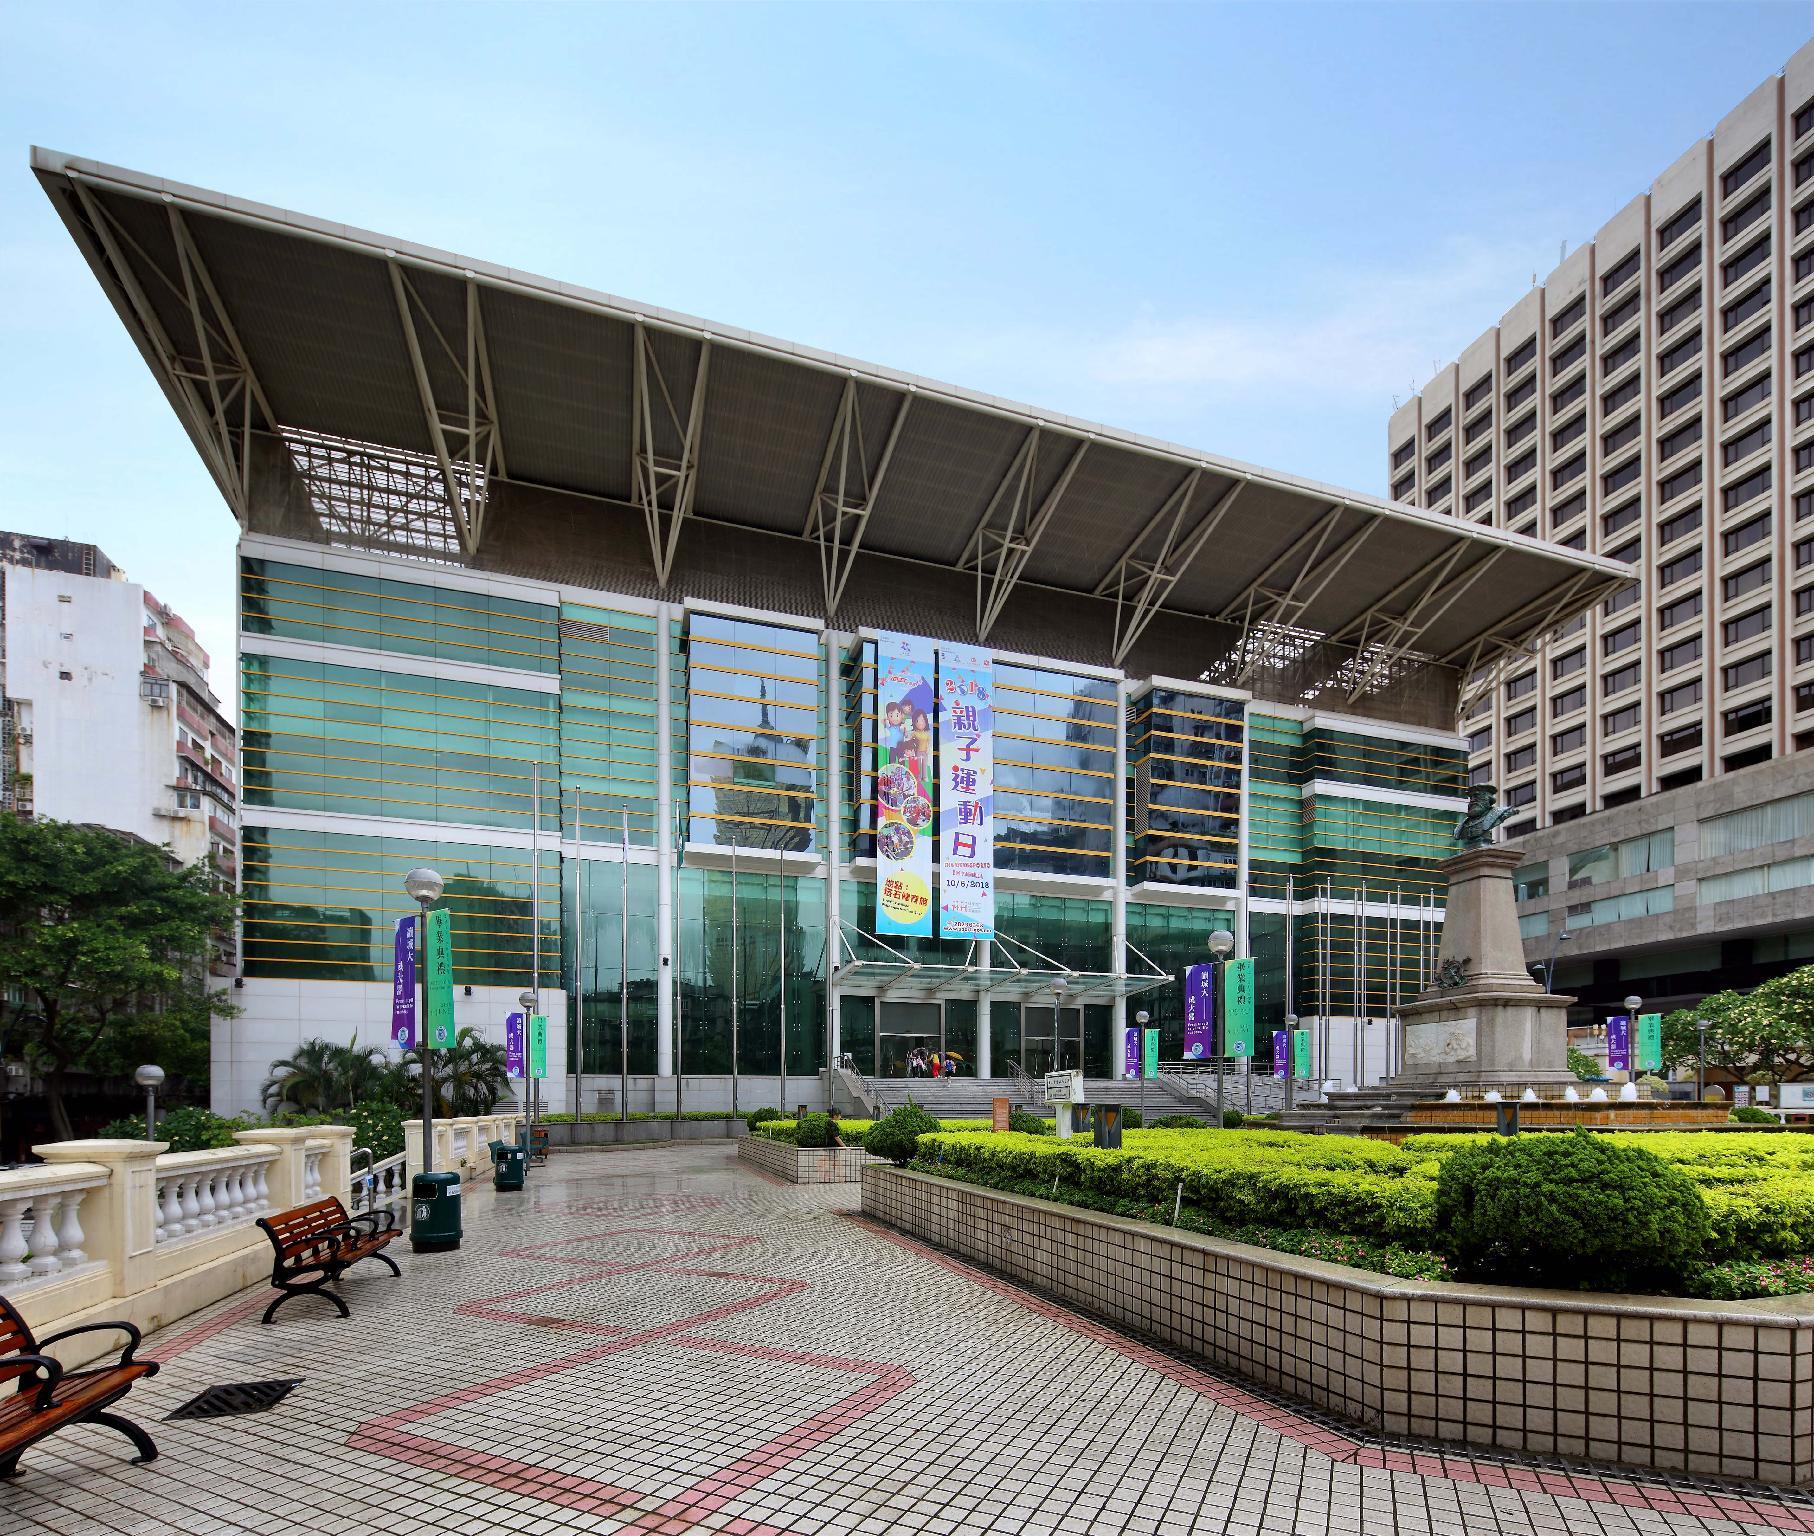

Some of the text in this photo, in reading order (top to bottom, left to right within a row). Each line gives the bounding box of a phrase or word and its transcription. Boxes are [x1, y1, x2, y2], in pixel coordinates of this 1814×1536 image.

[945, 680, 987, 702] 2018
[951, 700, 983, 859] 親子運動日
